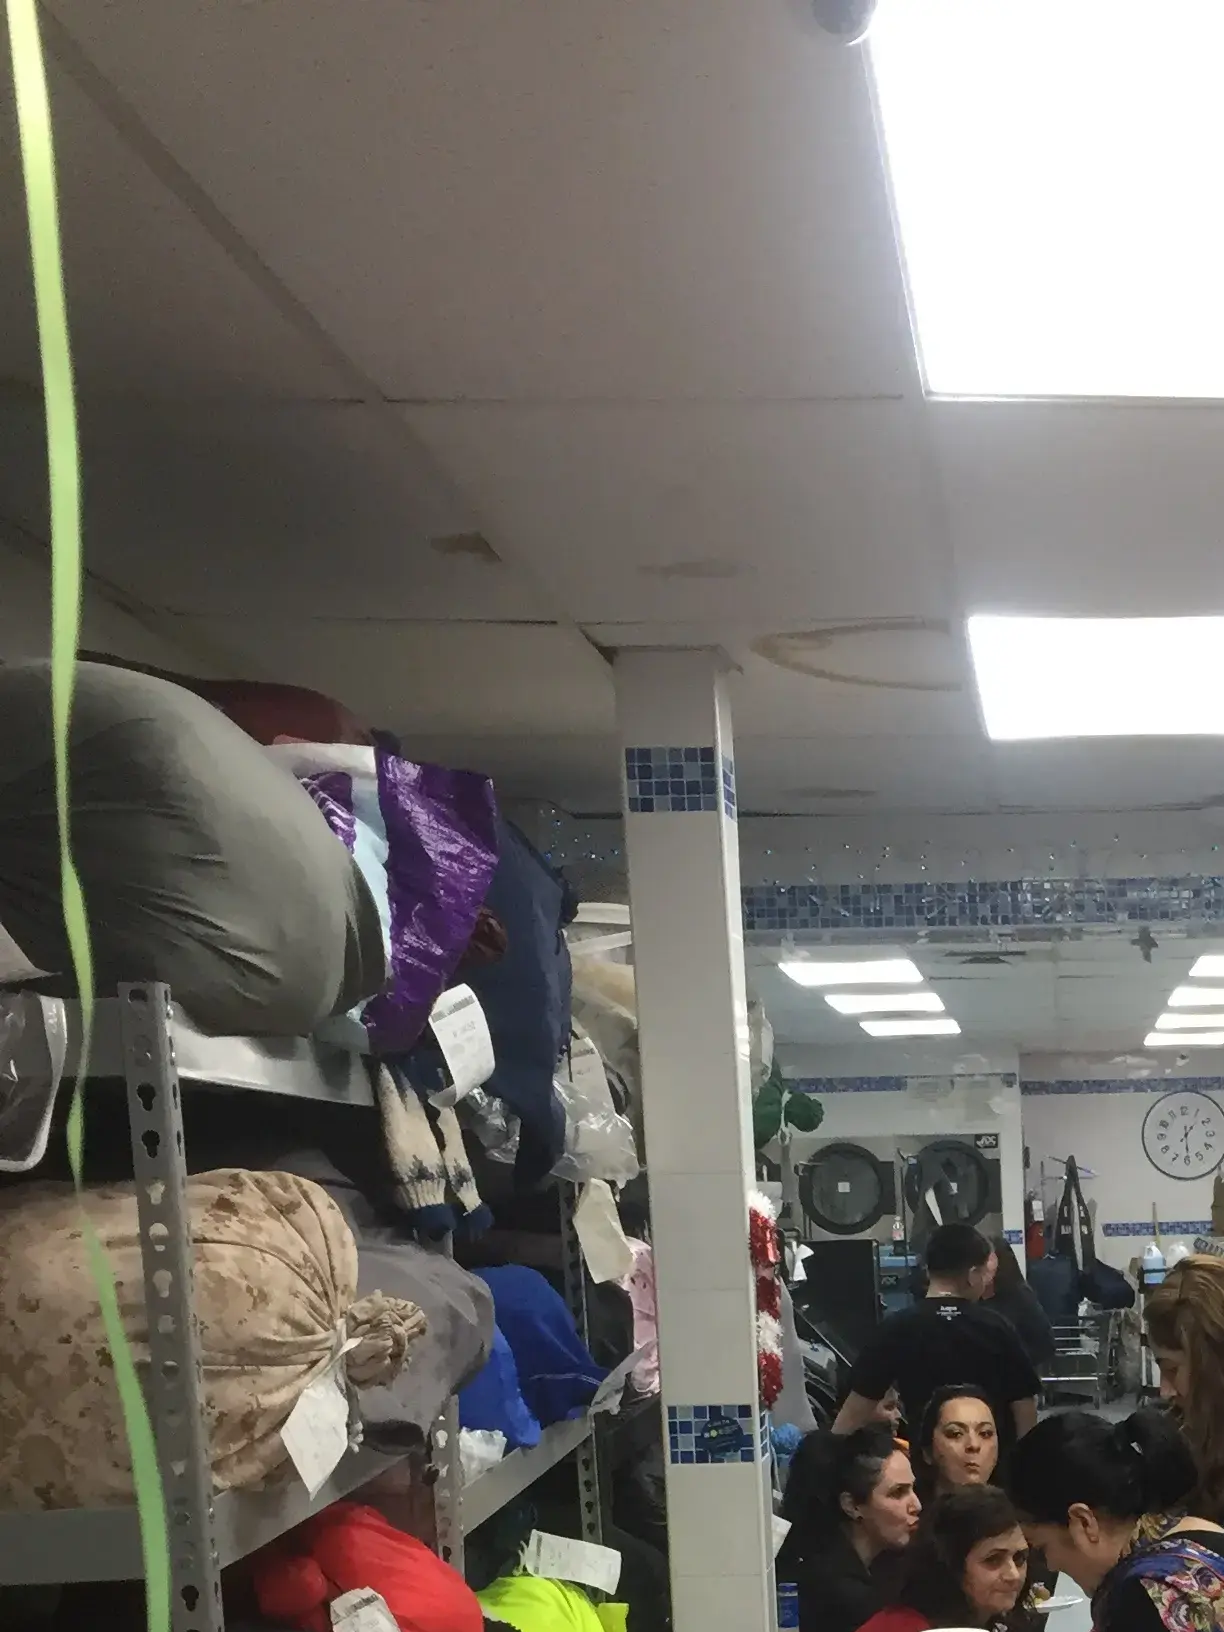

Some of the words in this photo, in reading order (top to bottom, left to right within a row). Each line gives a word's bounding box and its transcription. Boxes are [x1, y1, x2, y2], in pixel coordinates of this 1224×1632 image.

[1201, 1117, 1211, 1127] 2
[1157, 1132, 1167, 1141] 9
[1205, 1130, 1215, 1138] 3
[1160, 1145, 1170, 1154] 8
[1183, 1155, 1191, 1166] 6
[1195, 1151, 1204, 1161] 5
